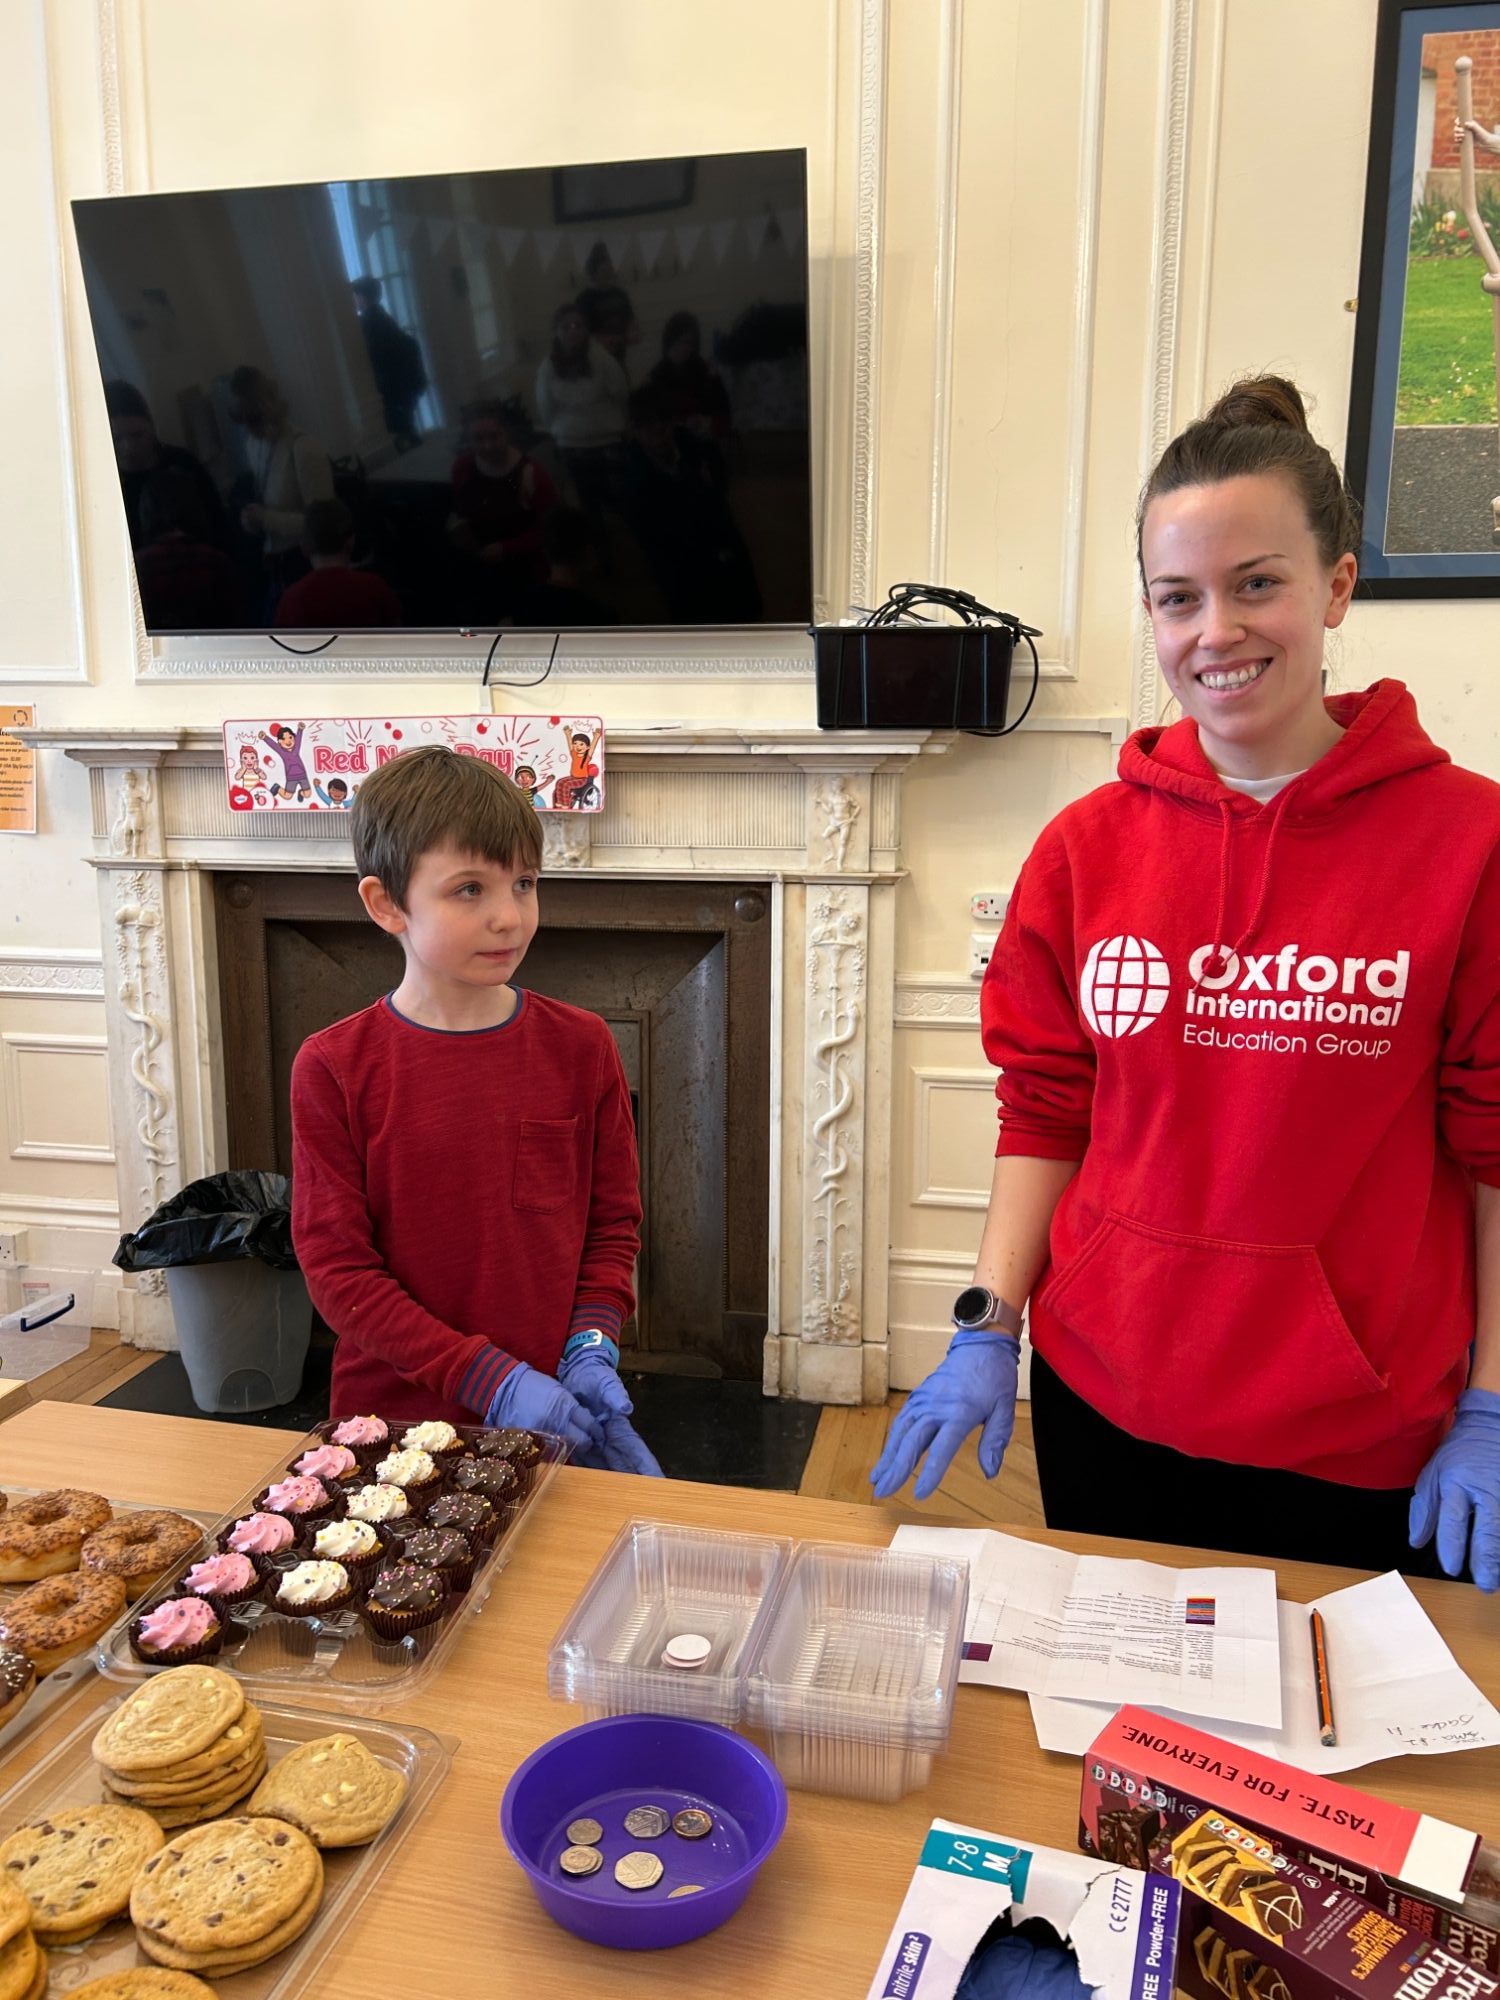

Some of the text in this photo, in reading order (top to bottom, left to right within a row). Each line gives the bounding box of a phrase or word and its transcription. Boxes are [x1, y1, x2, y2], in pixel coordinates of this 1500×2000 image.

[314, 743, 369, 773] Red
[1188, 943, 1411, 999] Oxford
[1185, 989, 1403, 1027] International
[1183, 1023, 1392, 1060] Education Group
[1121, 1724, 1240, 1782] EVERYONE.
[1243, 1773, 1291, 1802] FOR
[1298, 1793, 1376, 1839] TASTE.
[947, 1841, 980, 1871] 7-8
[982, 1852, 1012, 1874] M
[1141, 1887, 1168, 2000] REE Powder-FREE
[1346, 1910, 1382, 1942] SQUARES
[1350, 1917, 1395, 1958] SHORTCAKE
[1394, 1925, 1408, 1936] 5
[1447, 1916, 1475, 1954] Fro
[1351, 1930, 1403, 1980] MILLIONAIRE'S
[893, 1964, 915, 1998] nitrile
[1393, 1948, 1467, 2000] From
[1437, 1966, 1500, 2000] Fre
